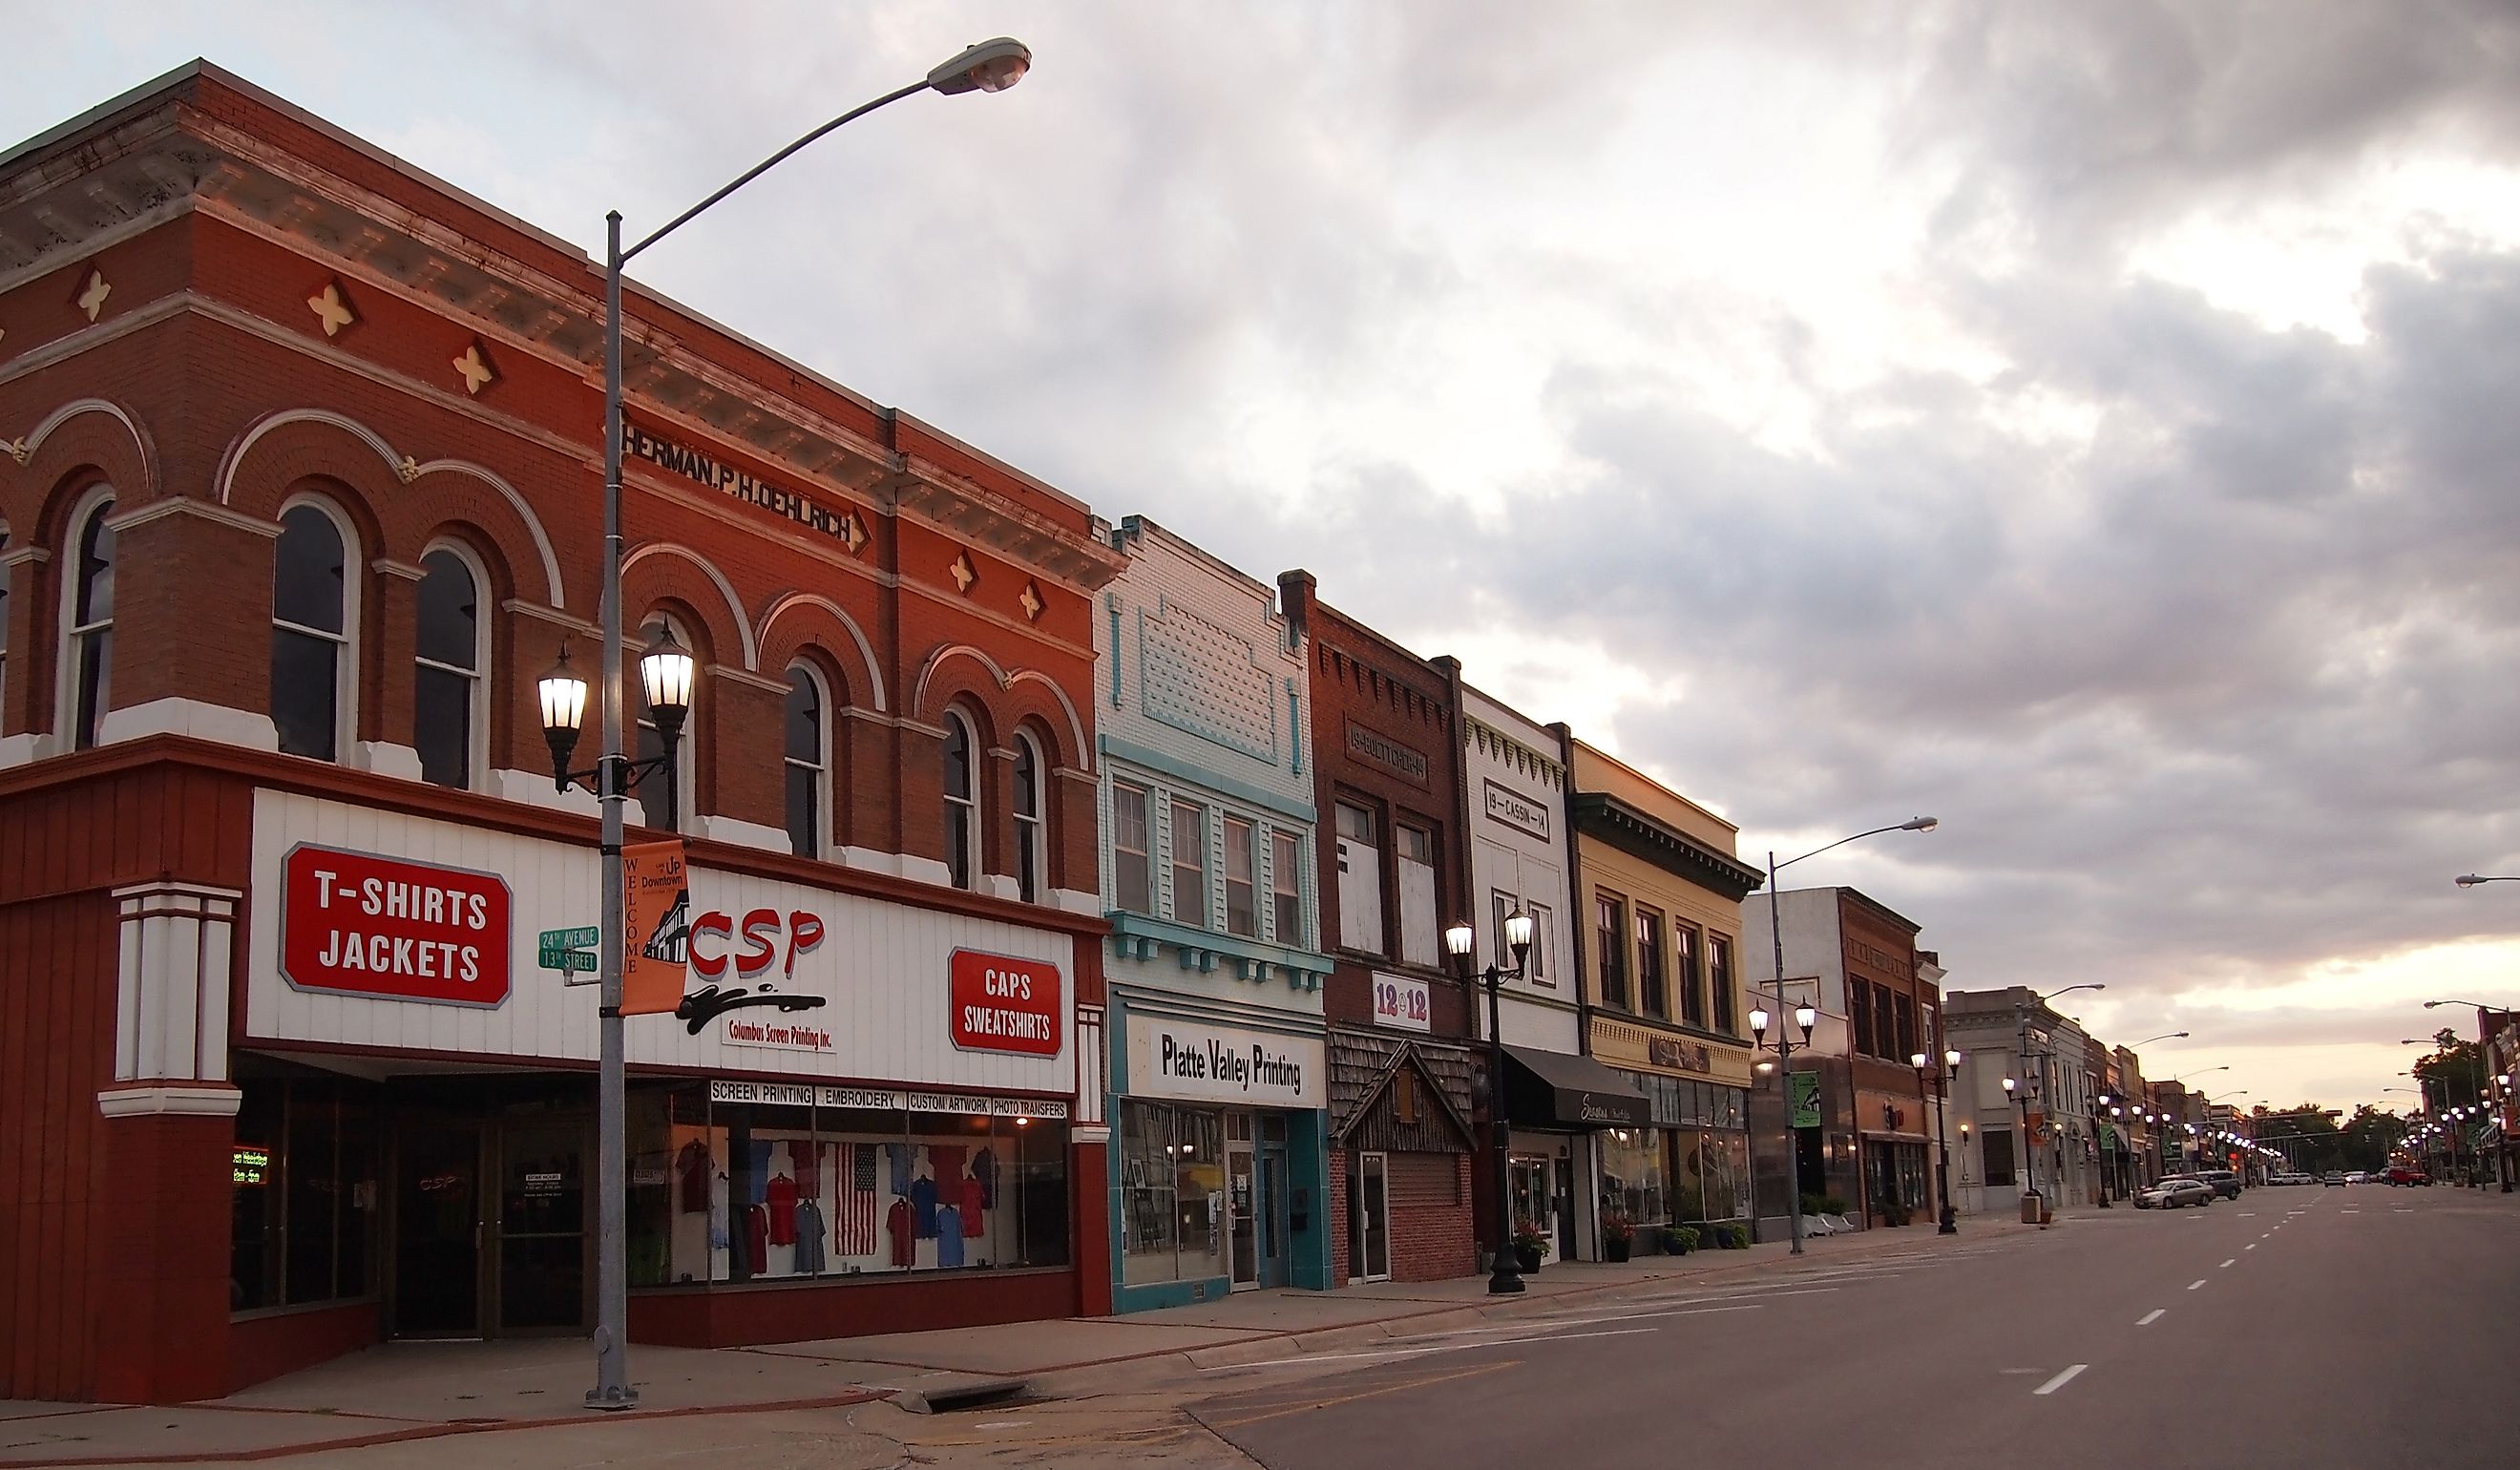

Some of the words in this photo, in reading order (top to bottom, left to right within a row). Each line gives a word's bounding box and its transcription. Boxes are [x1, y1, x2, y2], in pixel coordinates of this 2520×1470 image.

[666, 856, 681, 874] UP
[641, 875, 682, 888] Downtown
[313, 870, 488, 930] T-SHIRTS
[625, 858, 639, 974] WELCOME
[564, 929, 595, 946] AVENUE
[689, 908, 825, 980] CSP
[319, 930, 480, 982] JACKETS
[565, 954, 594, 970] STREET
[985, 969, 1031, 1000] CAPS
[728, 1019, 764, 1041] Columbus
[766, 1023, 789, 1044] Screen
[790, 1026, 819, 1051] Printing
[820, 1028, 831, 1047] Inc.
[964, 1005, 1050, 1040] SWEATSHIRTS
[1162, 1034, 1205, 1079] Platte
[1208, 1039, 1250, 1091] Valley
[1252, 1044, 1301, 1096] Printing
[712, 1082, 758, 1101] SCREEN
[763, 1085, 811, 1104] PRINTING
[825, 1089, 895, 1109] EMBROIDERY
[910, 1095, 945, 1111] CUSTOM
[948, 1097, 988, 1114] ARTWORK
[994, 1100, 1018, 1116] PHOTO
[1019, 1102, 1065, 1118] TRANSFERS
